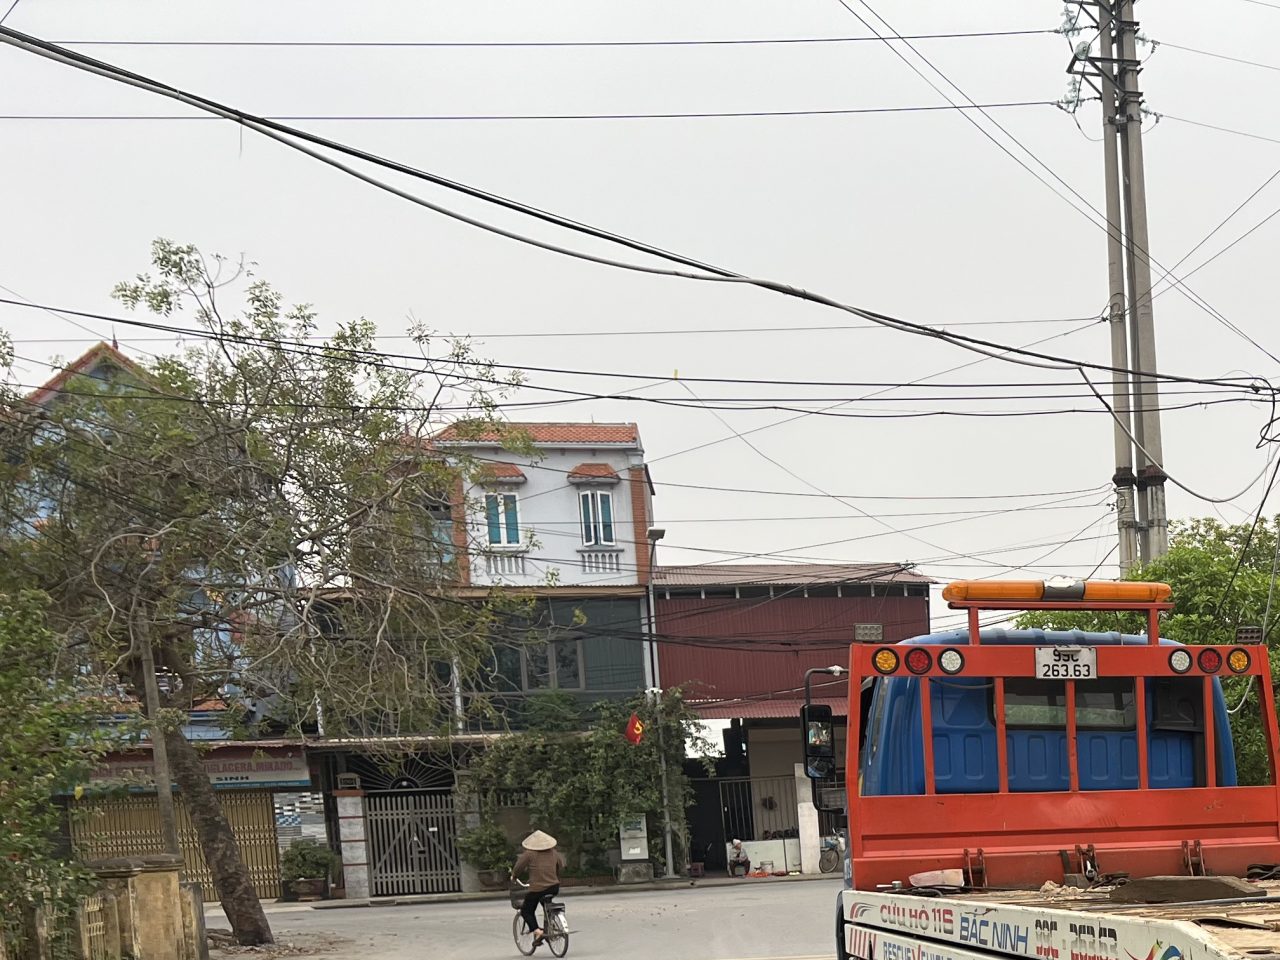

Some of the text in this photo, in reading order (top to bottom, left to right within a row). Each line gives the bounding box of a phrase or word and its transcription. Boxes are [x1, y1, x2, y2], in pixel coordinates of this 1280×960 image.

[1043, 664, 1091, 678] 263.63
[880, 900, 905, 926] CỨU
[909, 904, 929, 934] HỘ
[960, 908, 1028, 954] BẮC NINH
